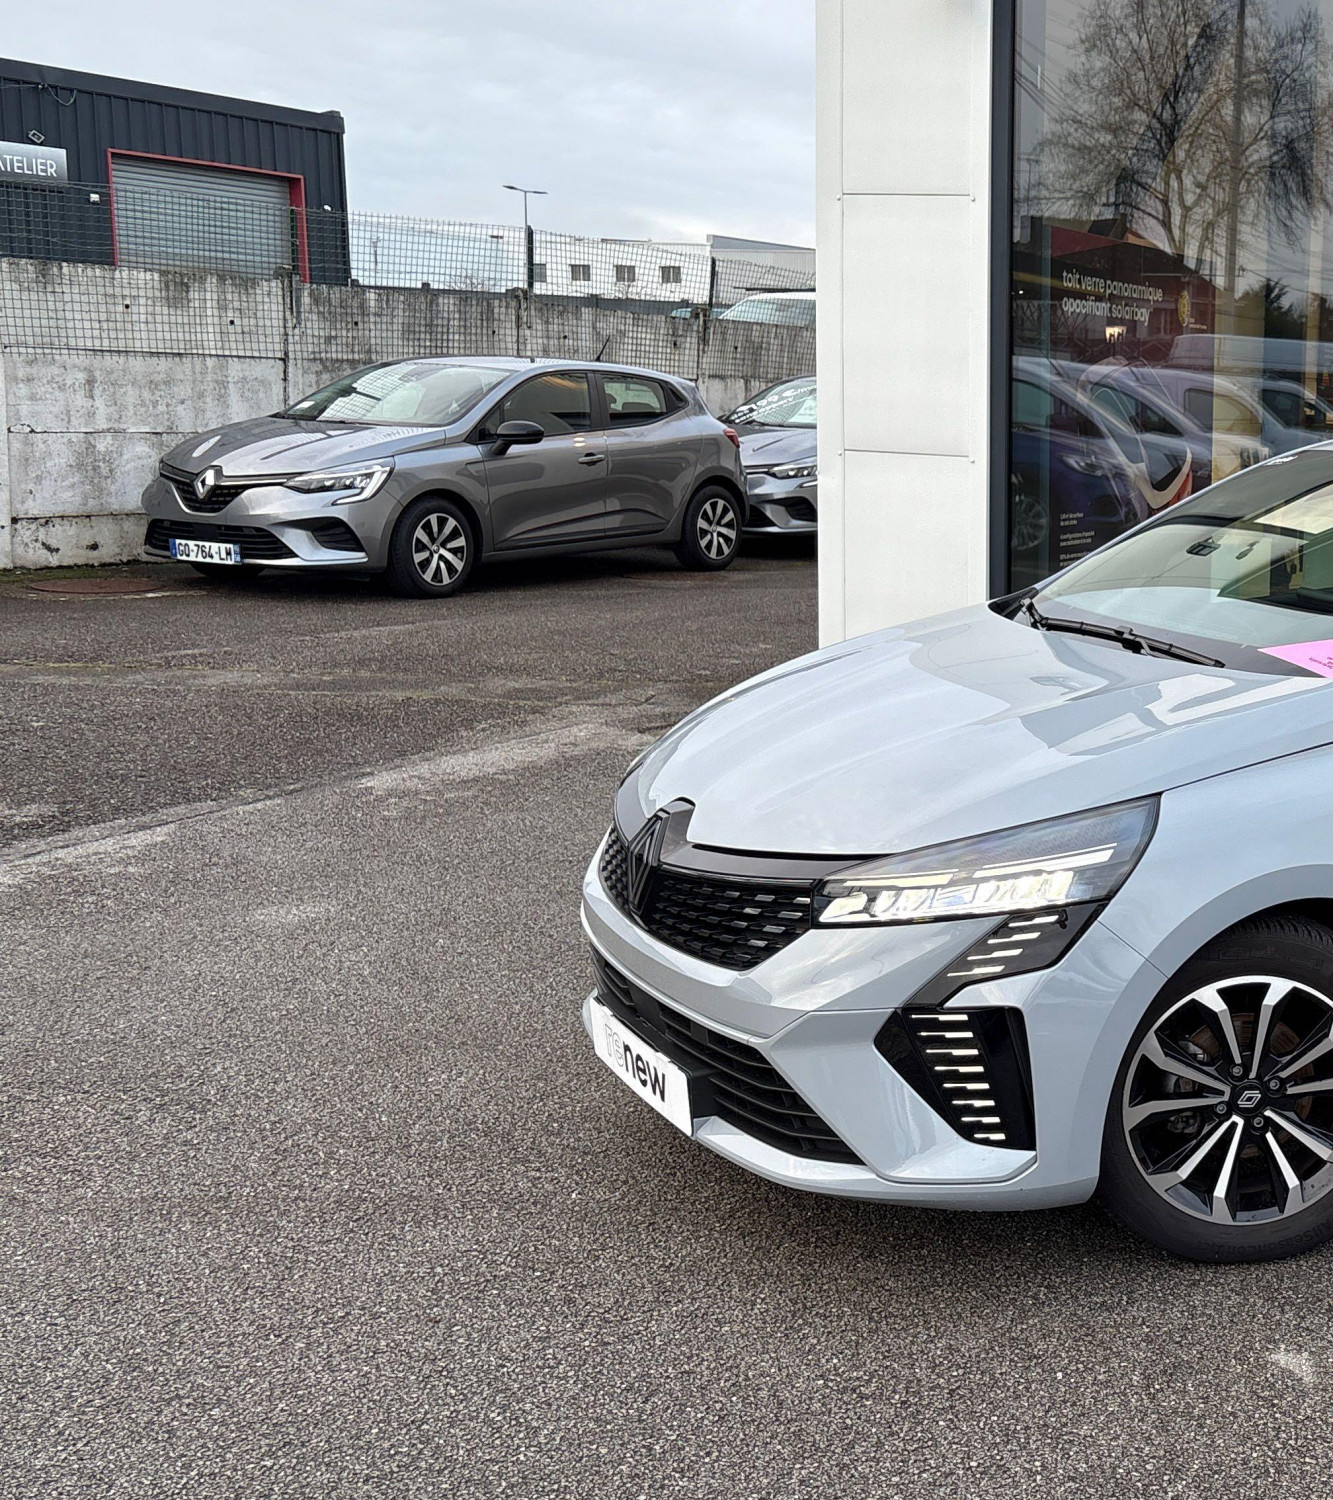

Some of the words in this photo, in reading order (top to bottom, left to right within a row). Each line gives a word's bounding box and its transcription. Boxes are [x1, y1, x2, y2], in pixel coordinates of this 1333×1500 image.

[0, 154, 57, 177] TELIER
[1062, 269, 1080, 288] toit
[1080, 274, 1105, 293] verre
[1106, 279, 1163, 305] panoramique
[1062, 295, 1111, 317] opacifiant
[604, 1023, 666, 1103] renew
